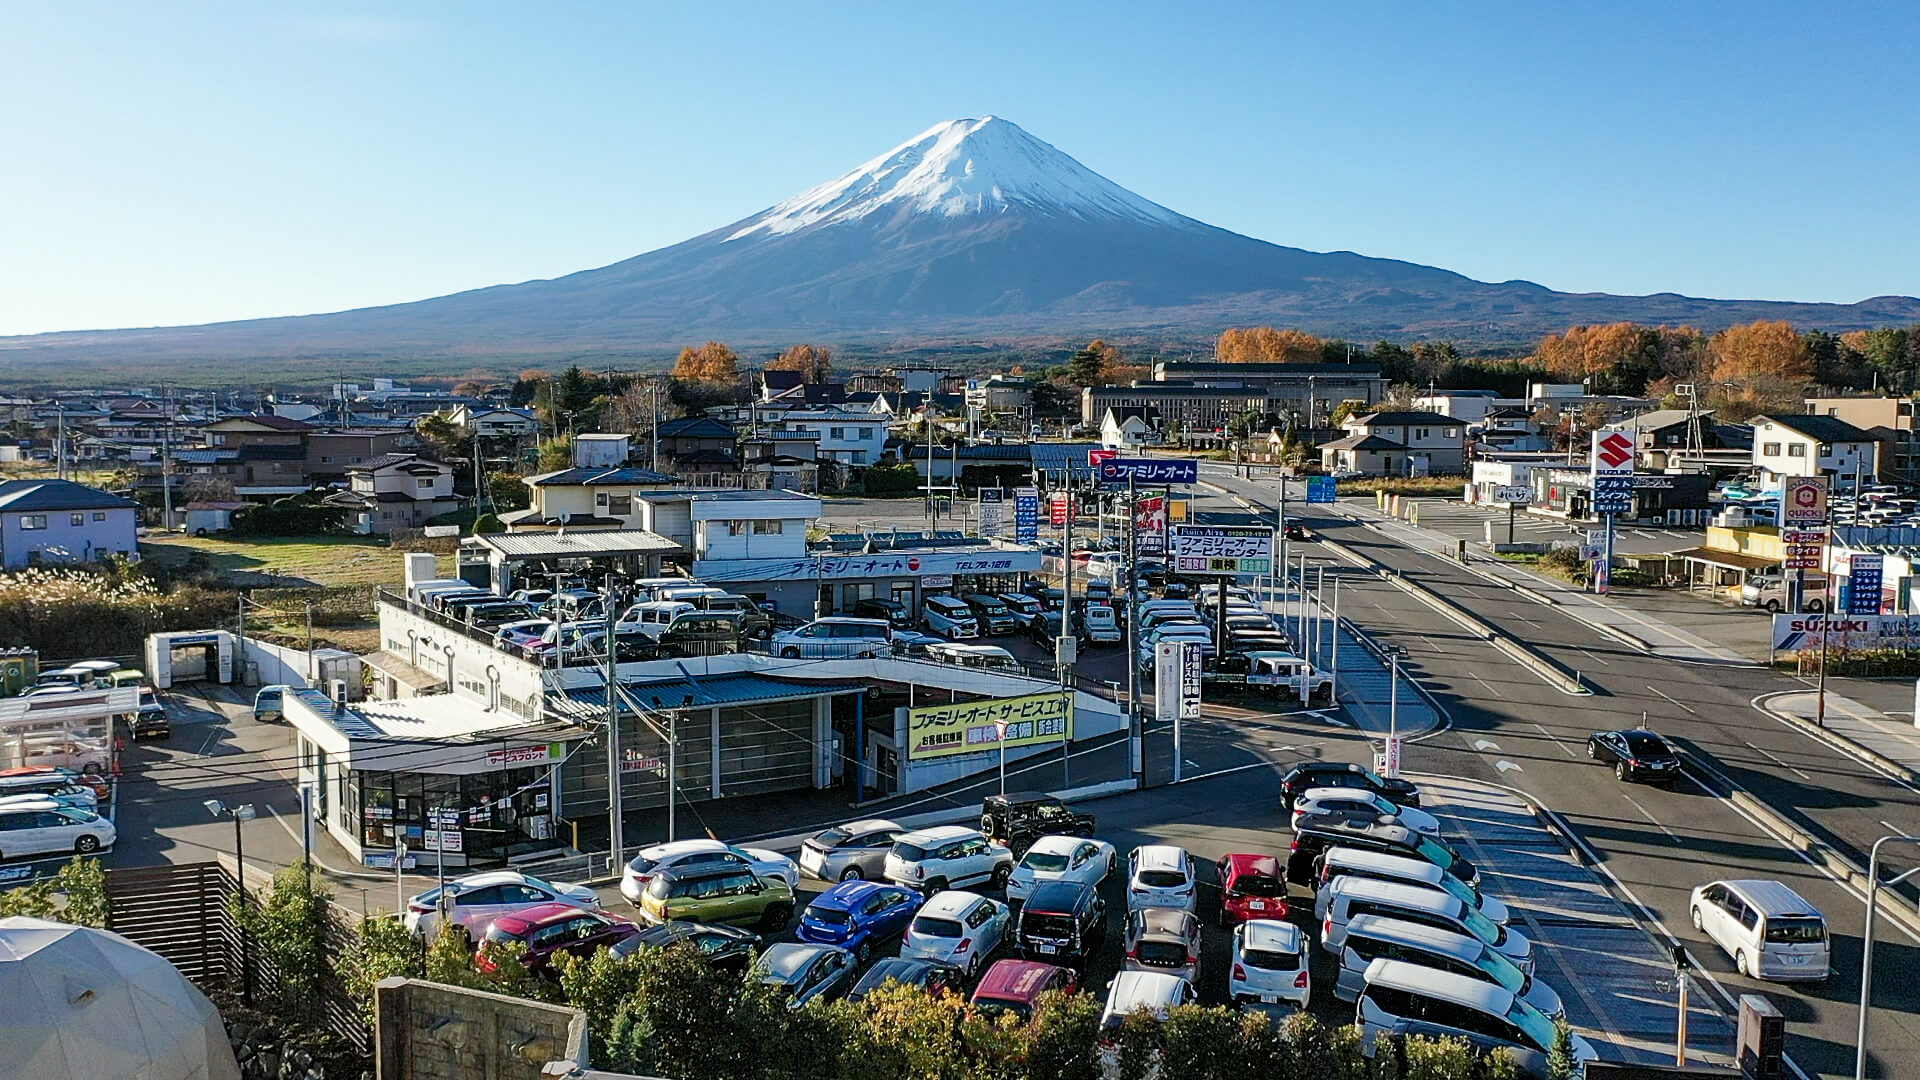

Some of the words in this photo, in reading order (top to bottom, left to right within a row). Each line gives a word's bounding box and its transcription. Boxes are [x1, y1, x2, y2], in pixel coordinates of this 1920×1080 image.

[1116, 464, 1195, 480] ファミリーオート
[1596, 480, 1631, 488] アルト
[1180, 537, 1268, 548] ファミリーオート
[1180, 546, 1268, 557] サービスセンター
[792, 560, 903, 573] ファミリーオート
[955, 561, 974, 569] TEL
[1790, 620, 1868, 632] SUZUKI
[913, 706, 997, 729] ファミリーオート
[1184, 708, 1199, 716] 入口
[490, 751, 545, 765] サービスフロント
